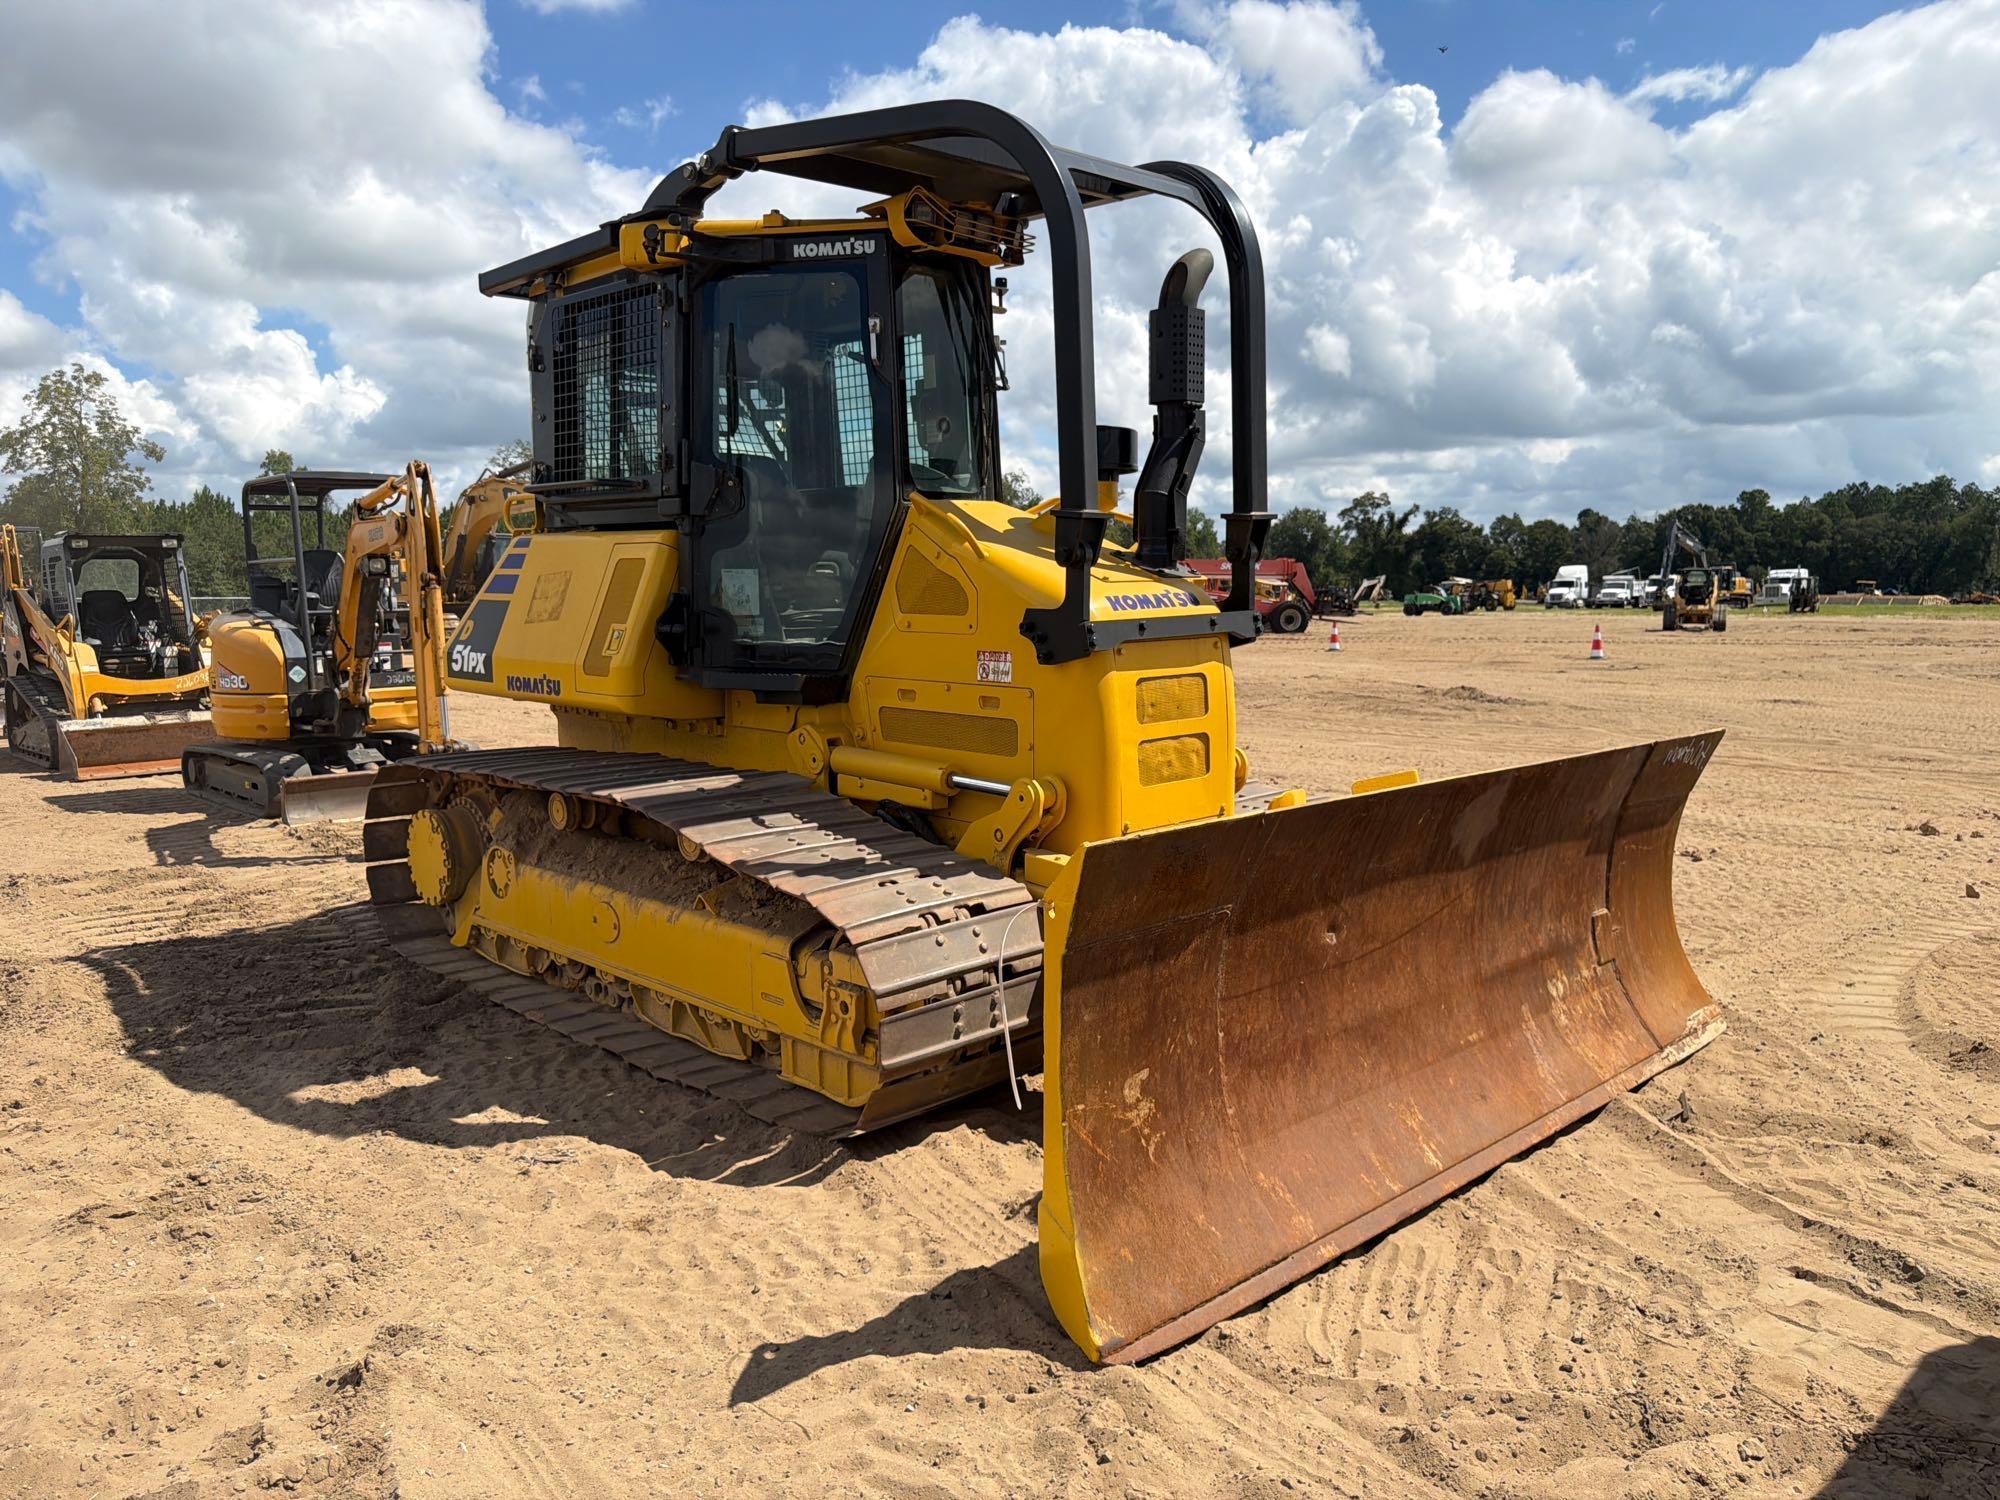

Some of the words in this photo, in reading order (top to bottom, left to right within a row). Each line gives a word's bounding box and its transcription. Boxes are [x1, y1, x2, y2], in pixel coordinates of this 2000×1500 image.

[793, 237, 876, 258] KOMATSU
[1105, 589, 1200, 611] KOMATSU
[451, 644, 487, 675] 51PX
[506, 673, 561, 697] KOMATSU
